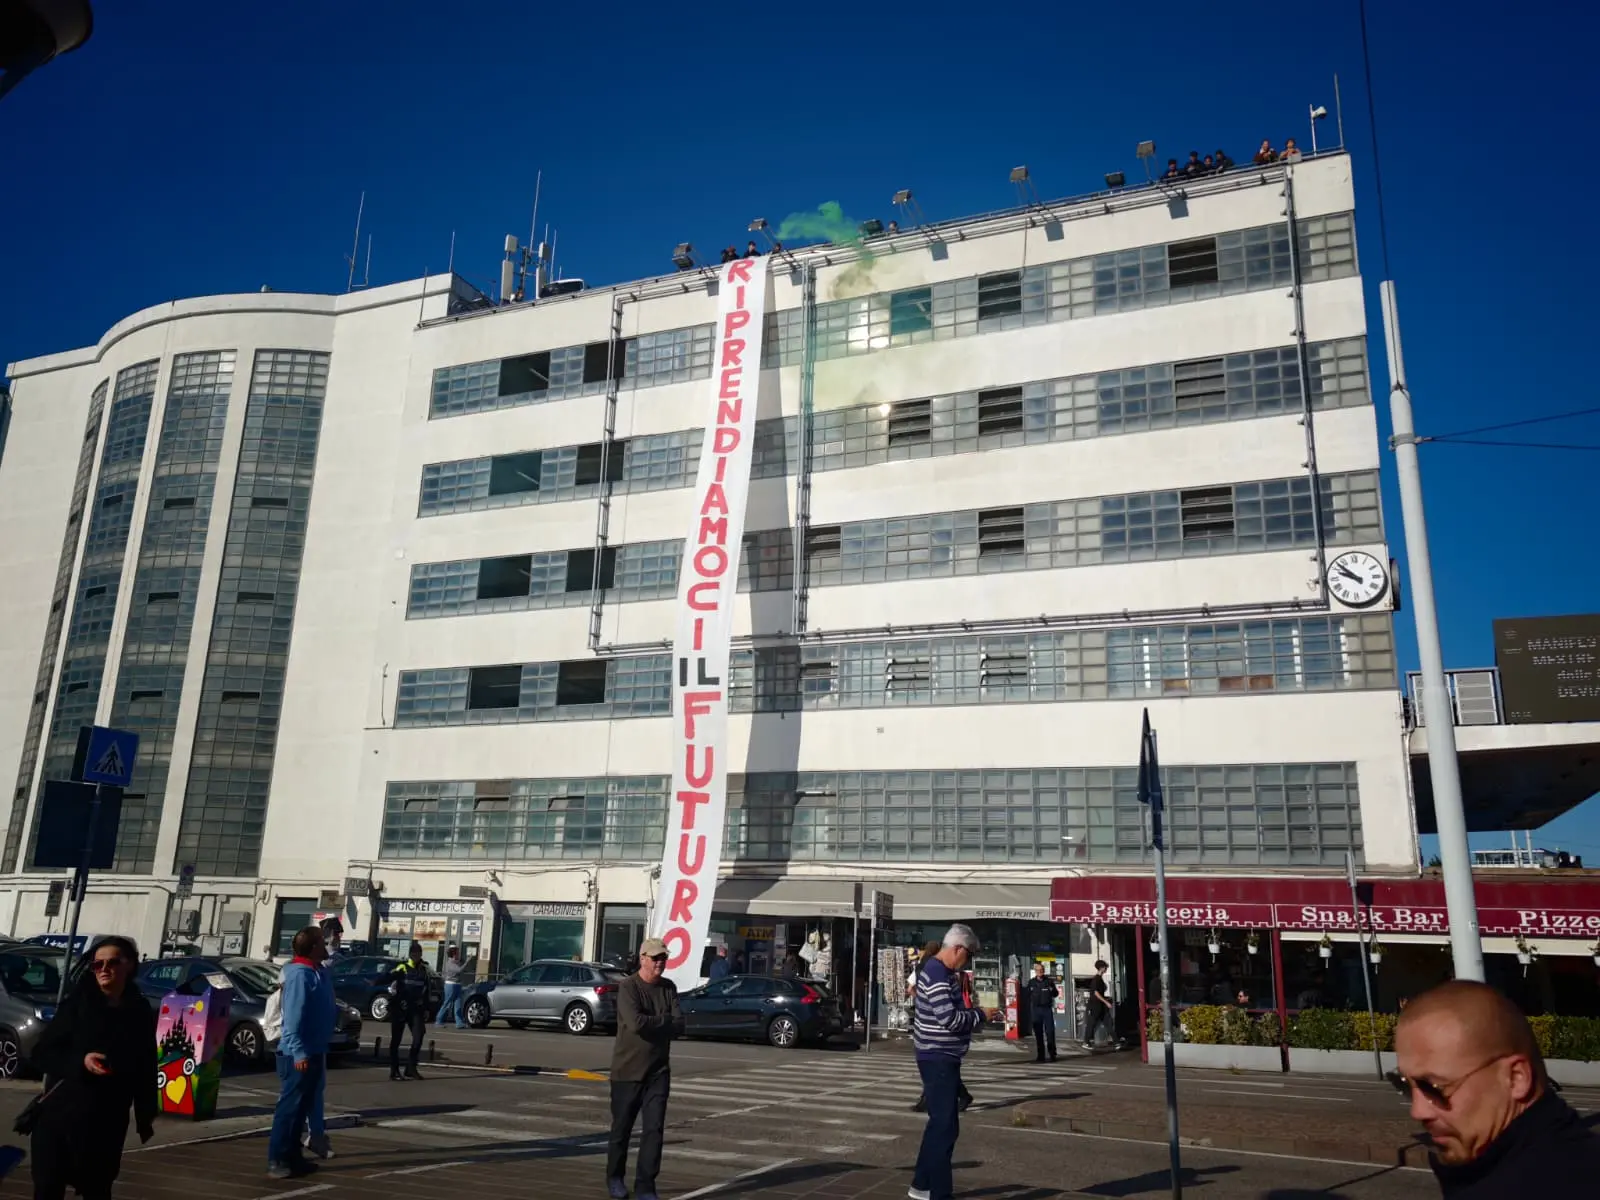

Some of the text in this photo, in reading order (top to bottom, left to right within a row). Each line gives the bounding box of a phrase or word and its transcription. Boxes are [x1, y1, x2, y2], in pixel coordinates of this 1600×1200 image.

[663, 258, 755, 970] RIPRENDIAMOCI IL FUTURO
[400, 901, 431, 912] TICKET
[433, 902, 466, 913] OFFICE
[532, 903, 586, 916] CARABINIERI
[1301, 906, 1444, 926] Snack Bar
[1517, 910, 1600, 928] Pizze
[746, 928, 774, 939] ATM
